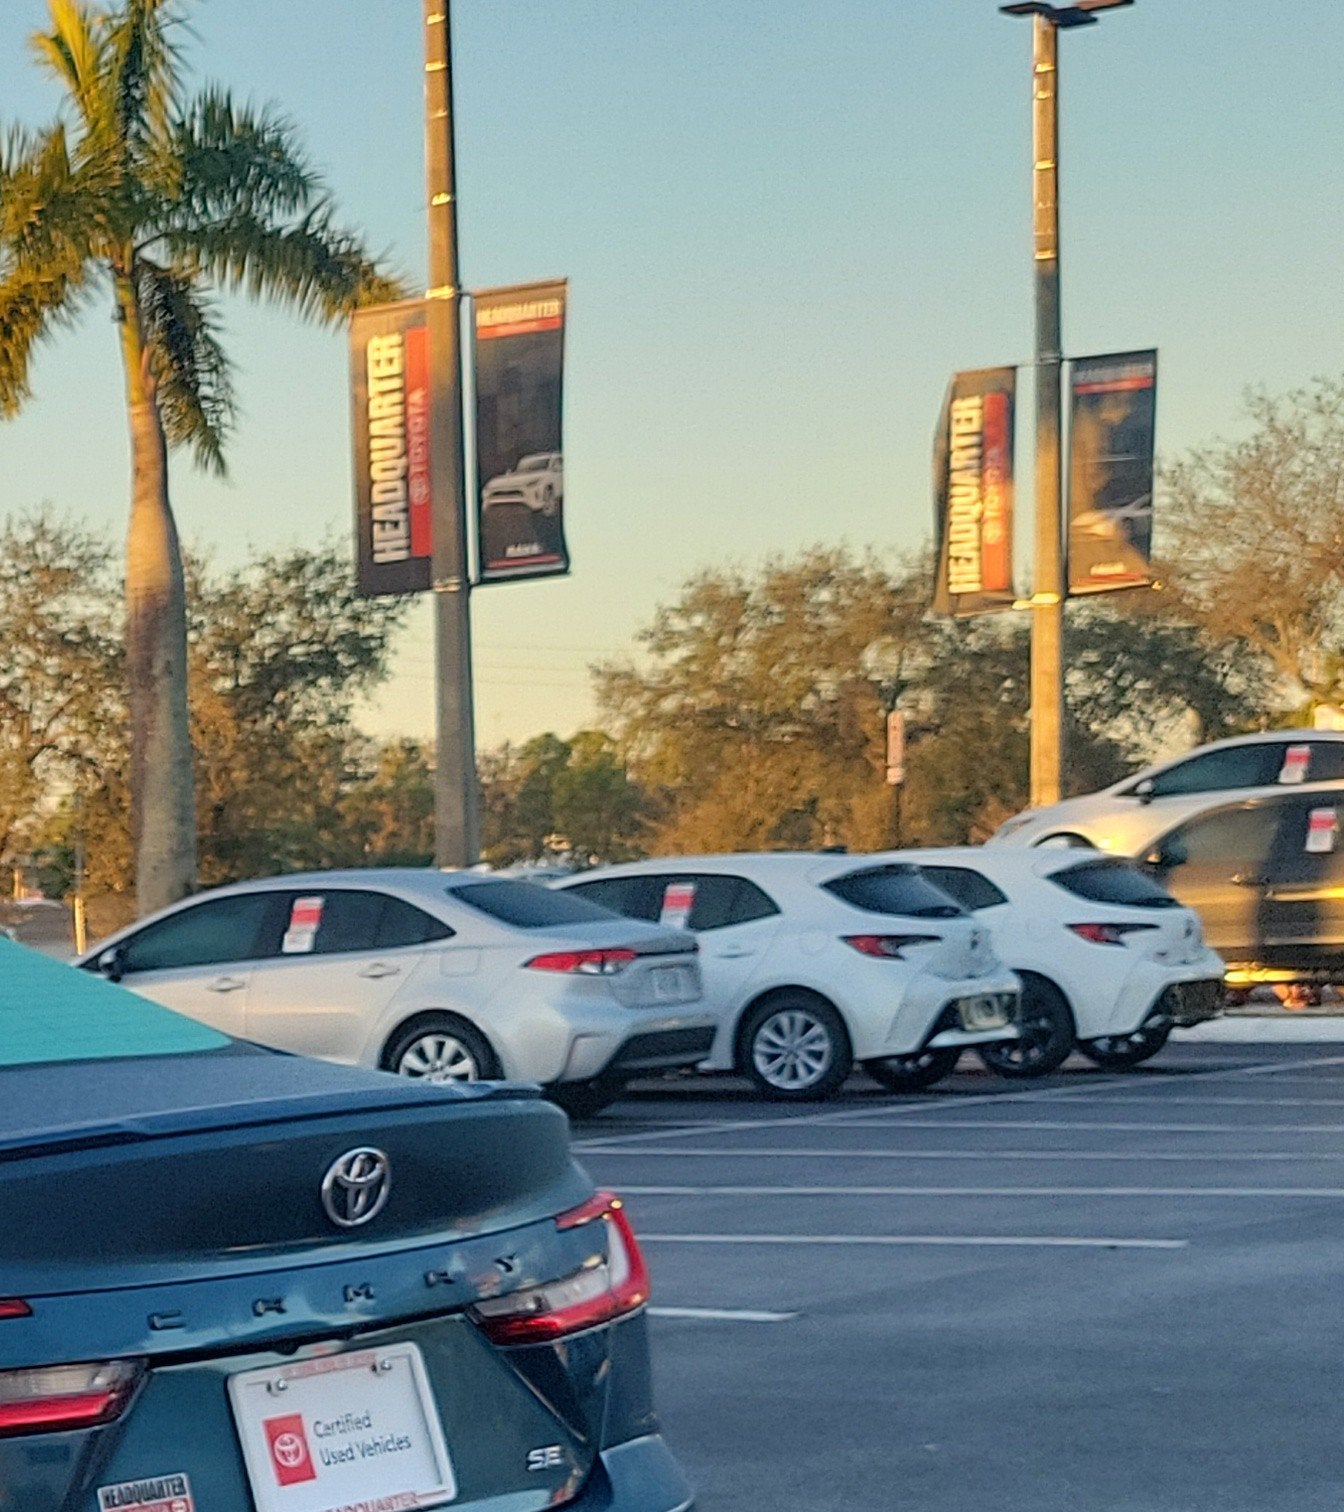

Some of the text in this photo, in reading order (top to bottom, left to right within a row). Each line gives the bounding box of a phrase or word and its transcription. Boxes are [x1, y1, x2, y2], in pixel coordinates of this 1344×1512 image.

[367, 332, 410, 564] HEADQUARTER
[313, 1410, 372, 1438] Certified
[320, 1433, 412, 1466] Used Vehicles
[528, 1445, 562, 1471] SE
[101, 1476, 187, 1510] HEADQUARTER
